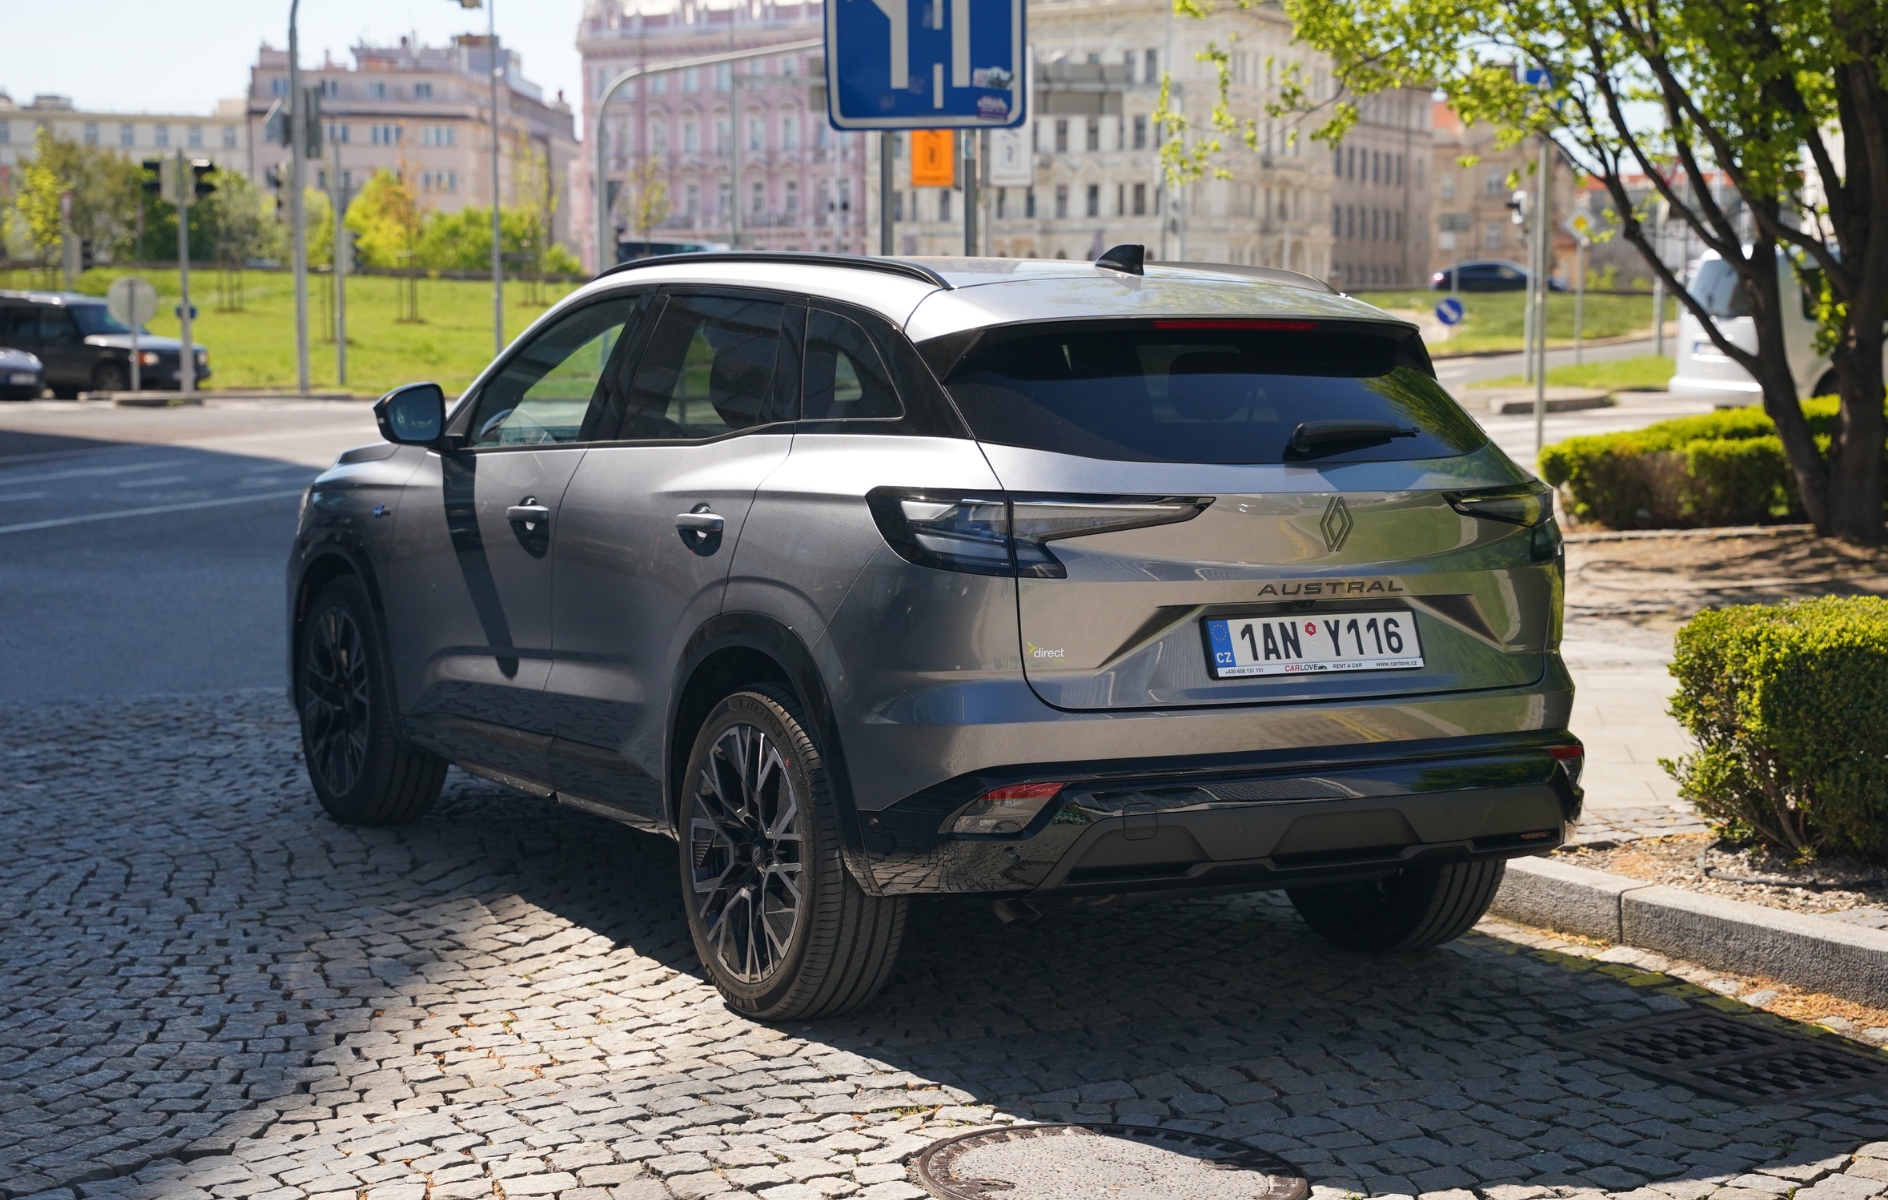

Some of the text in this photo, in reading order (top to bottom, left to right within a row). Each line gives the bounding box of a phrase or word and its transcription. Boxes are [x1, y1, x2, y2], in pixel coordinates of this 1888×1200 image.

[1257, 580, 1404, 597] AUSTRAL
[1240, 617, 1404, 661] 1AN Y116
[1033, 648, 1065, 658] direct
[1216, 651, 1233, 664] CZ
[1284, 663, 1318, 672] CARLOVE
